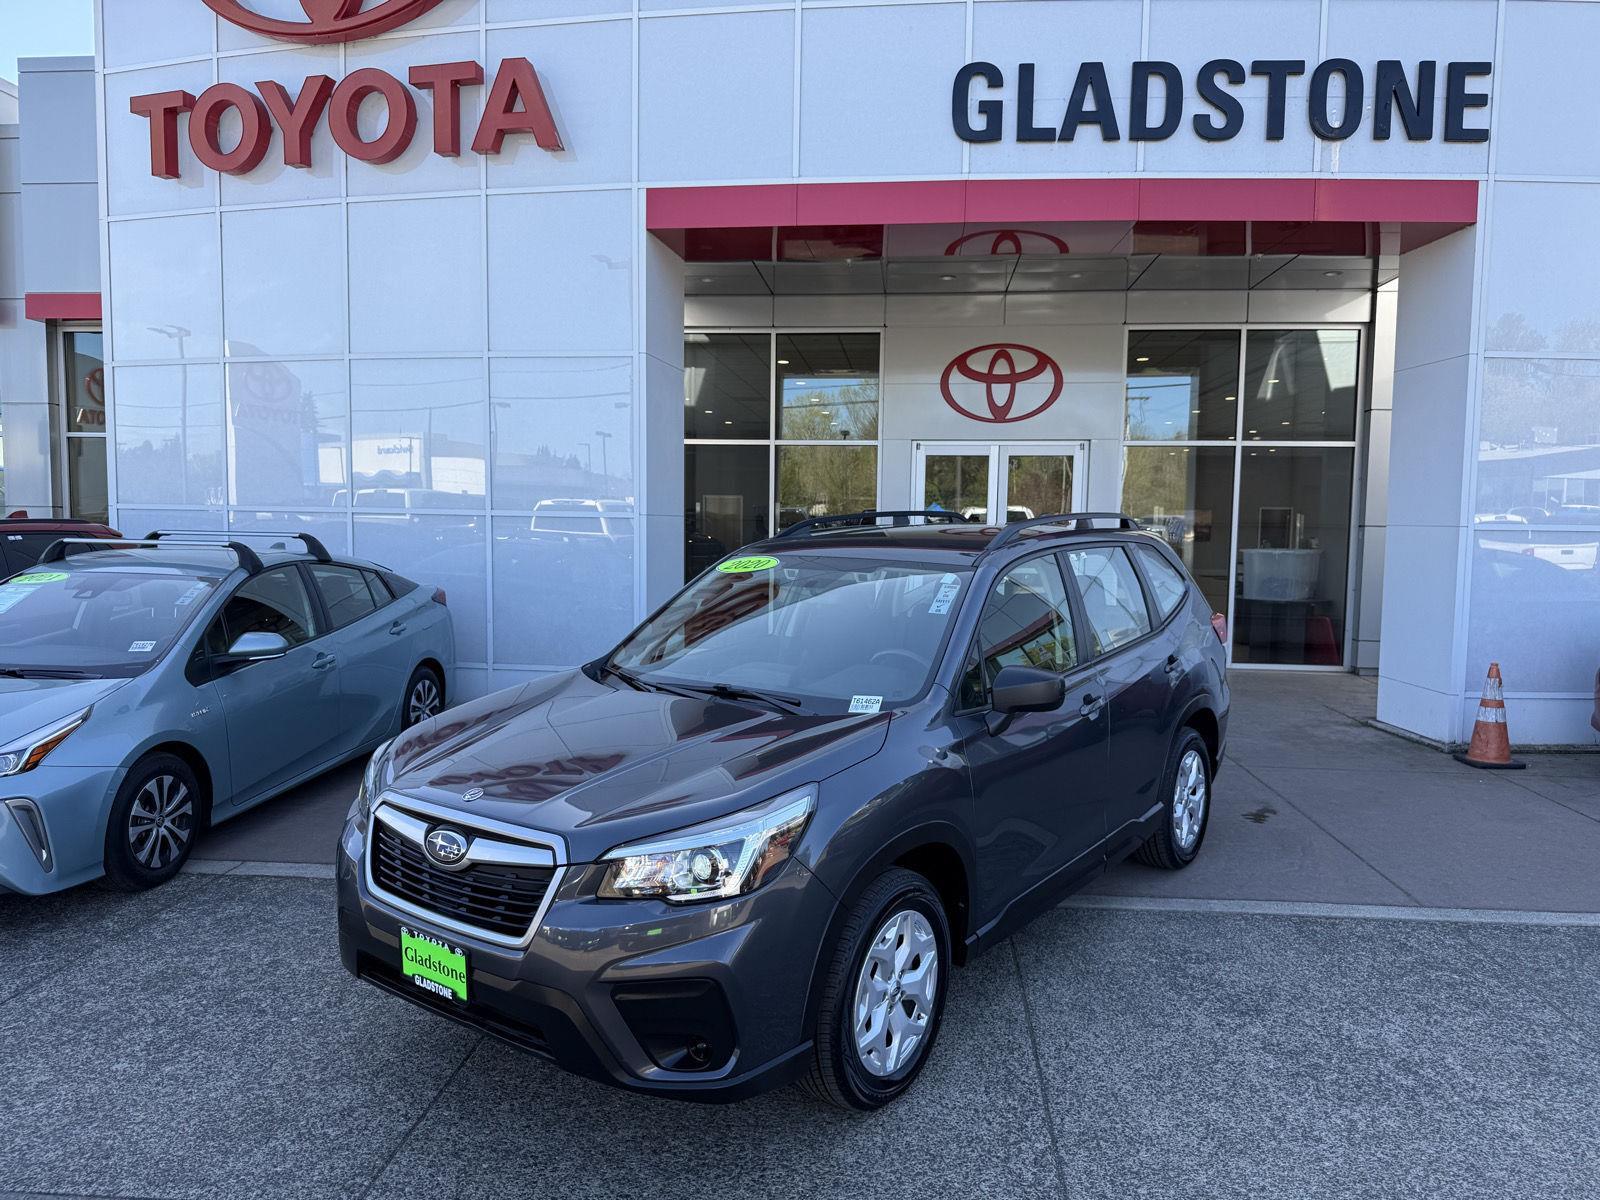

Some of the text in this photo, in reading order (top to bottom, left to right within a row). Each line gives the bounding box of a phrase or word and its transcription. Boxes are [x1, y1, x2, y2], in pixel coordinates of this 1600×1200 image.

[951, 58, 1492, 143] GLADSTONE
[130, 57, 565, 180] TOYOTA
[723, 560, 771, 570] 2020
[413, 930, 450, 950] TOYOTA
[404, 946, 466, 983] Gladstone
[414, 974, 453, 999] GLADSTONE
